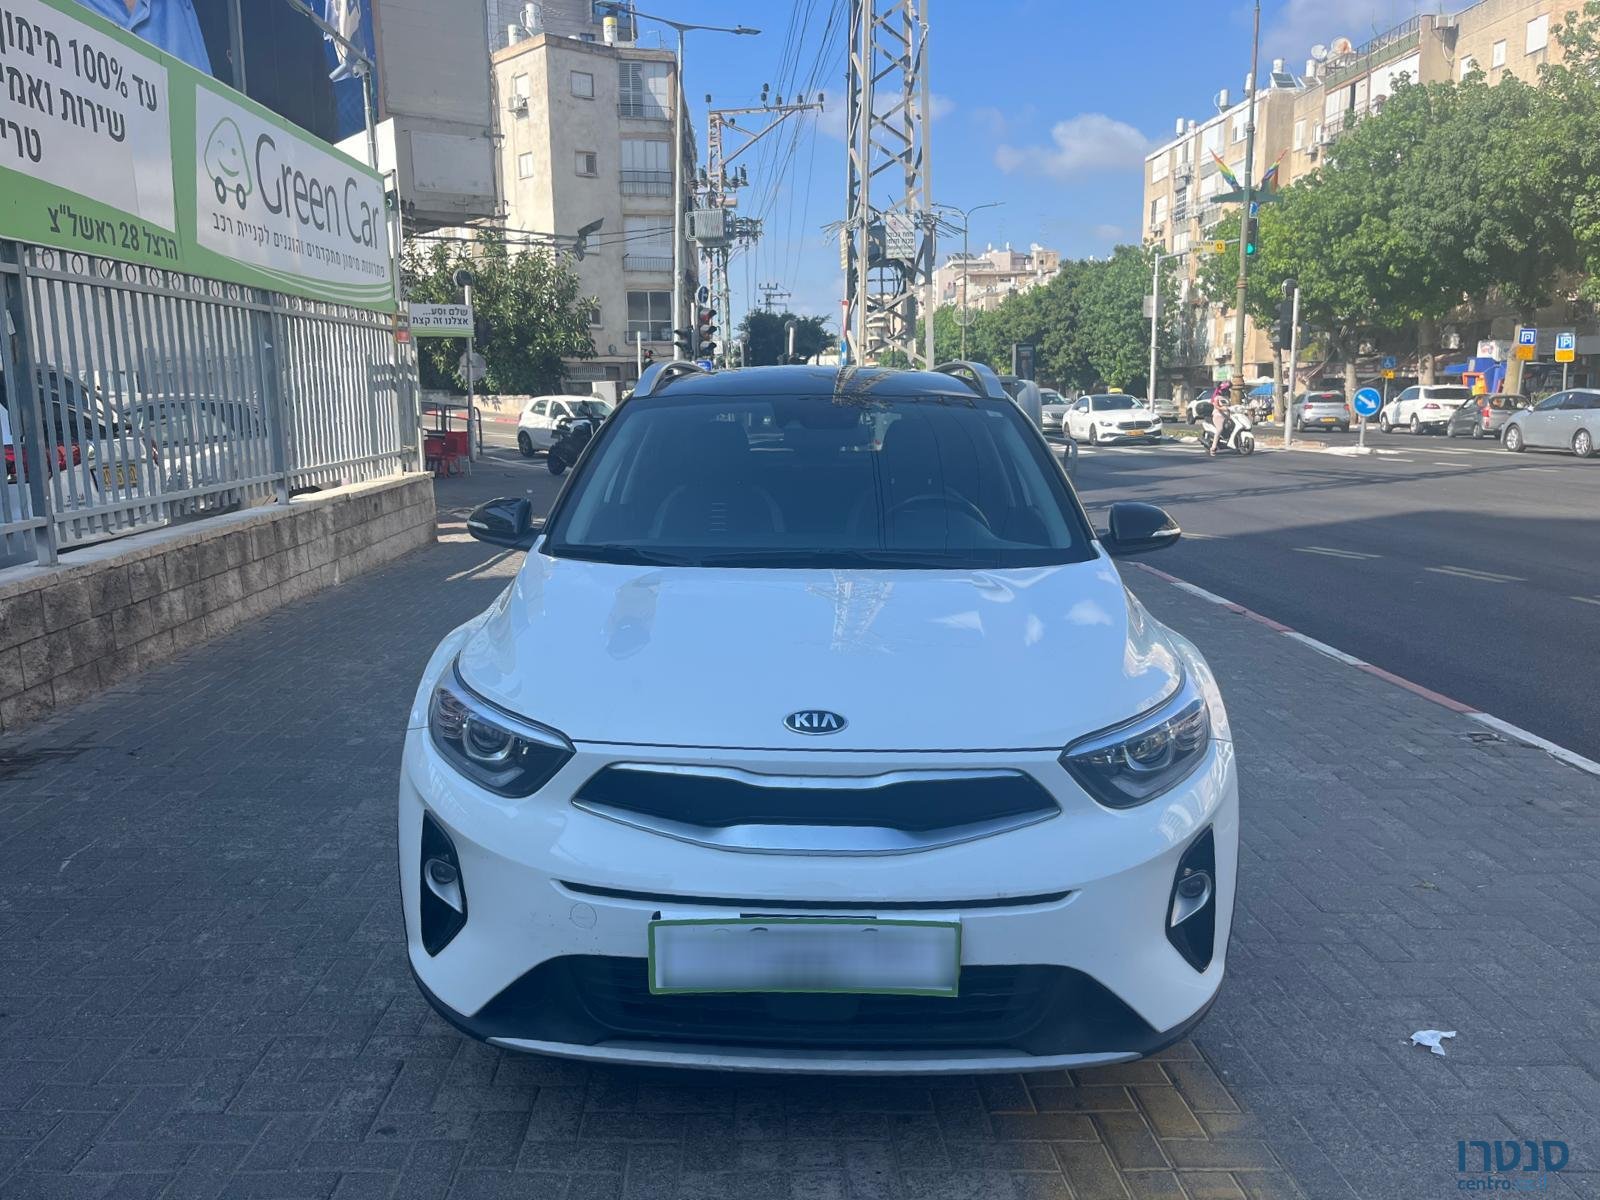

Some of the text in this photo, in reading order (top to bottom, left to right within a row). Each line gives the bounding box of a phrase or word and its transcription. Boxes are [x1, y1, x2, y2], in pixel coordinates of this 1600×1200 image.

[69, 39, 128, 98] 100%
[132, 74, 157, 112] עד
[60, 88, 125, 142] שירות
[255, 133, 379, 249] Green Car
[48, 204, 178, 260] הרצל 28 ראשל"צ
[212, 212, 233, 235] רכב
[237, 220, 270, 247] לקניית
[273, 232, 305, 255] והוגנים
[306, 243, 341, 266] מתקדמים
[412, 316, 469, 327] אצלנו זה קצת
[449, 307, 468, 316] שלם
[794, 712, 838, 728] KIA
